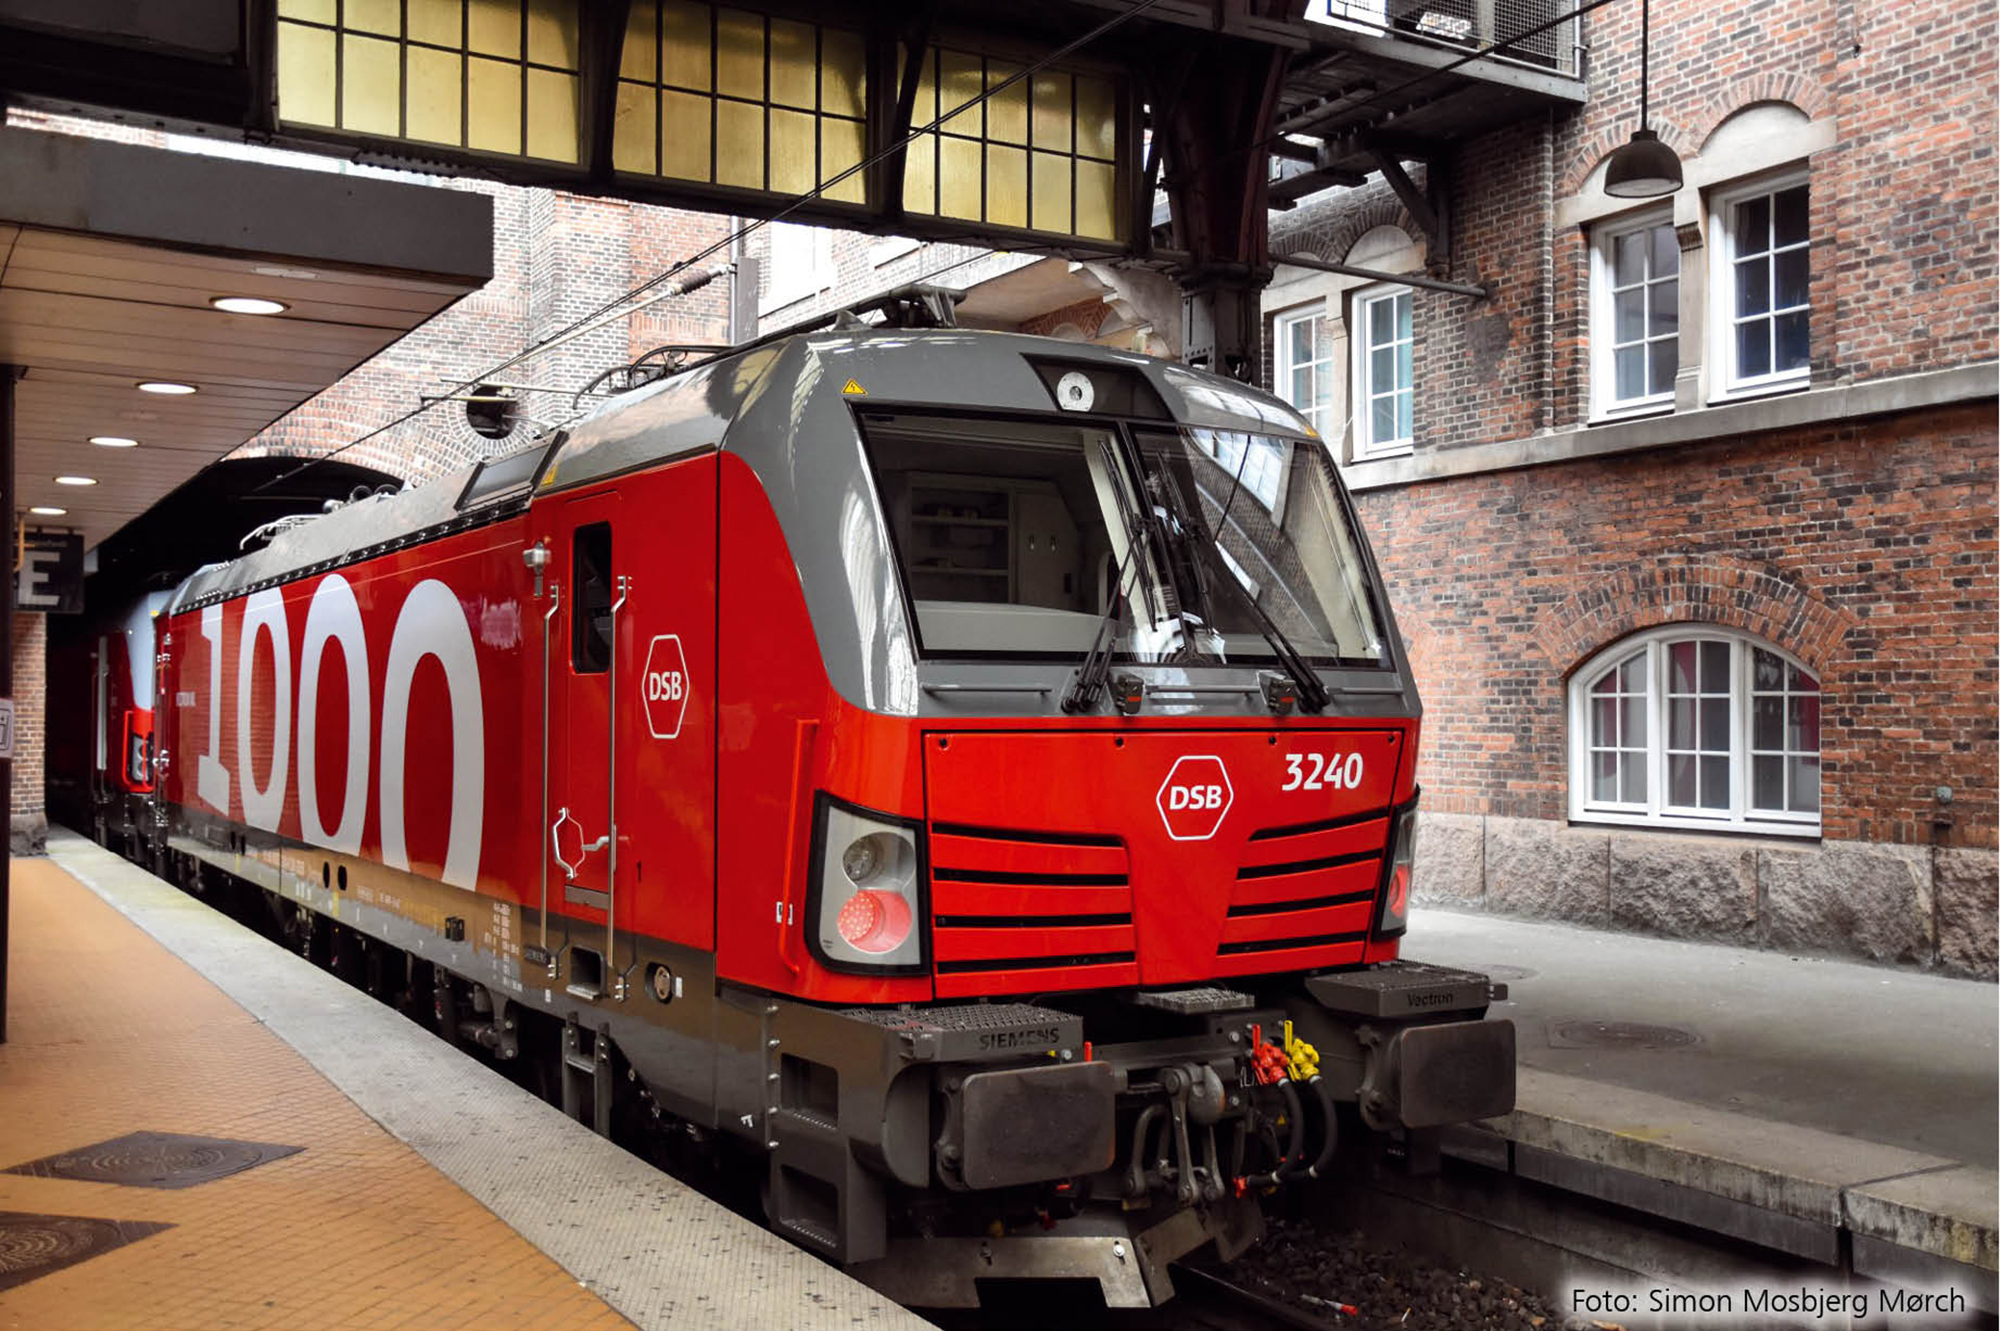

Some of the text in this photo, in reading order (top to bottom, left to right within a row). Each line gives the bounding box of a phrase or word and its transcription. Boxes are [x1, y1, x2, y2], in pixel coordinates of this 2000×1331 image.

[18, 550, 61, 606] E
[649, 671, 682, 701] DSB
[197, 573, 485, 891] 1000
[1281, 752, 1364, 792] 3240
[1169, 784, 1223, 811] DSB
[1407, 992, 1454, 1007] Vectron
[979, 1027, 1061, 1051] SIEMENS
